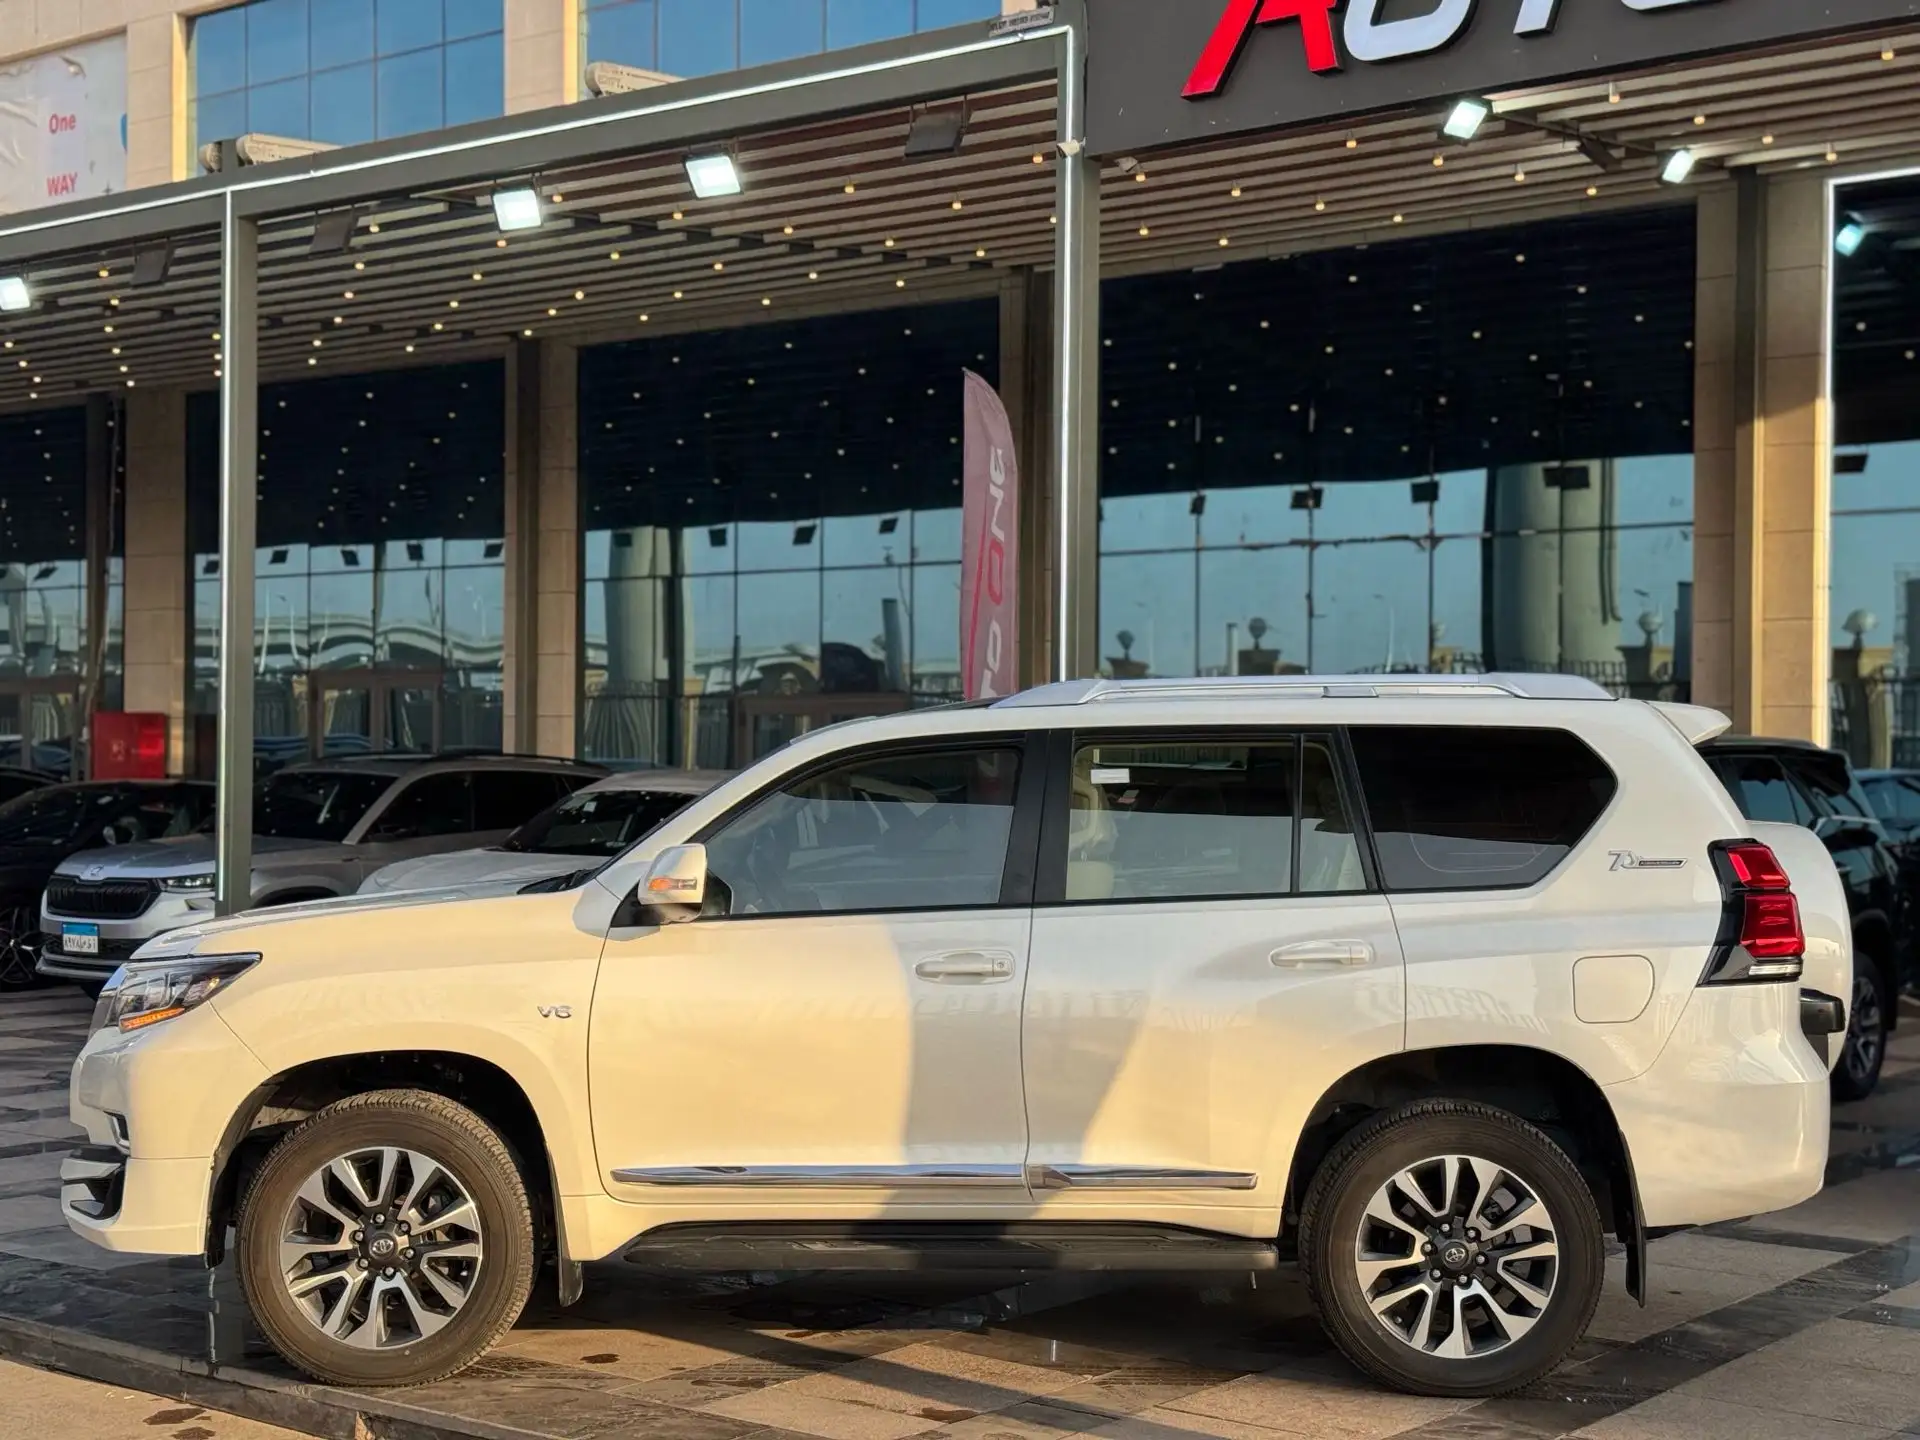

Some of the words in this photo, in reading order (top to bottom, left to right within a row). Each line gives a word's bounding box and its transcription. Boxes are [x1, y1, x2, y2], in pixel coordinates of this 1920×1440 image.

[49, 113, 76, 134] One
[47, 172, 77, 196] WAY
[537, 1005, 571, 1019] V6
